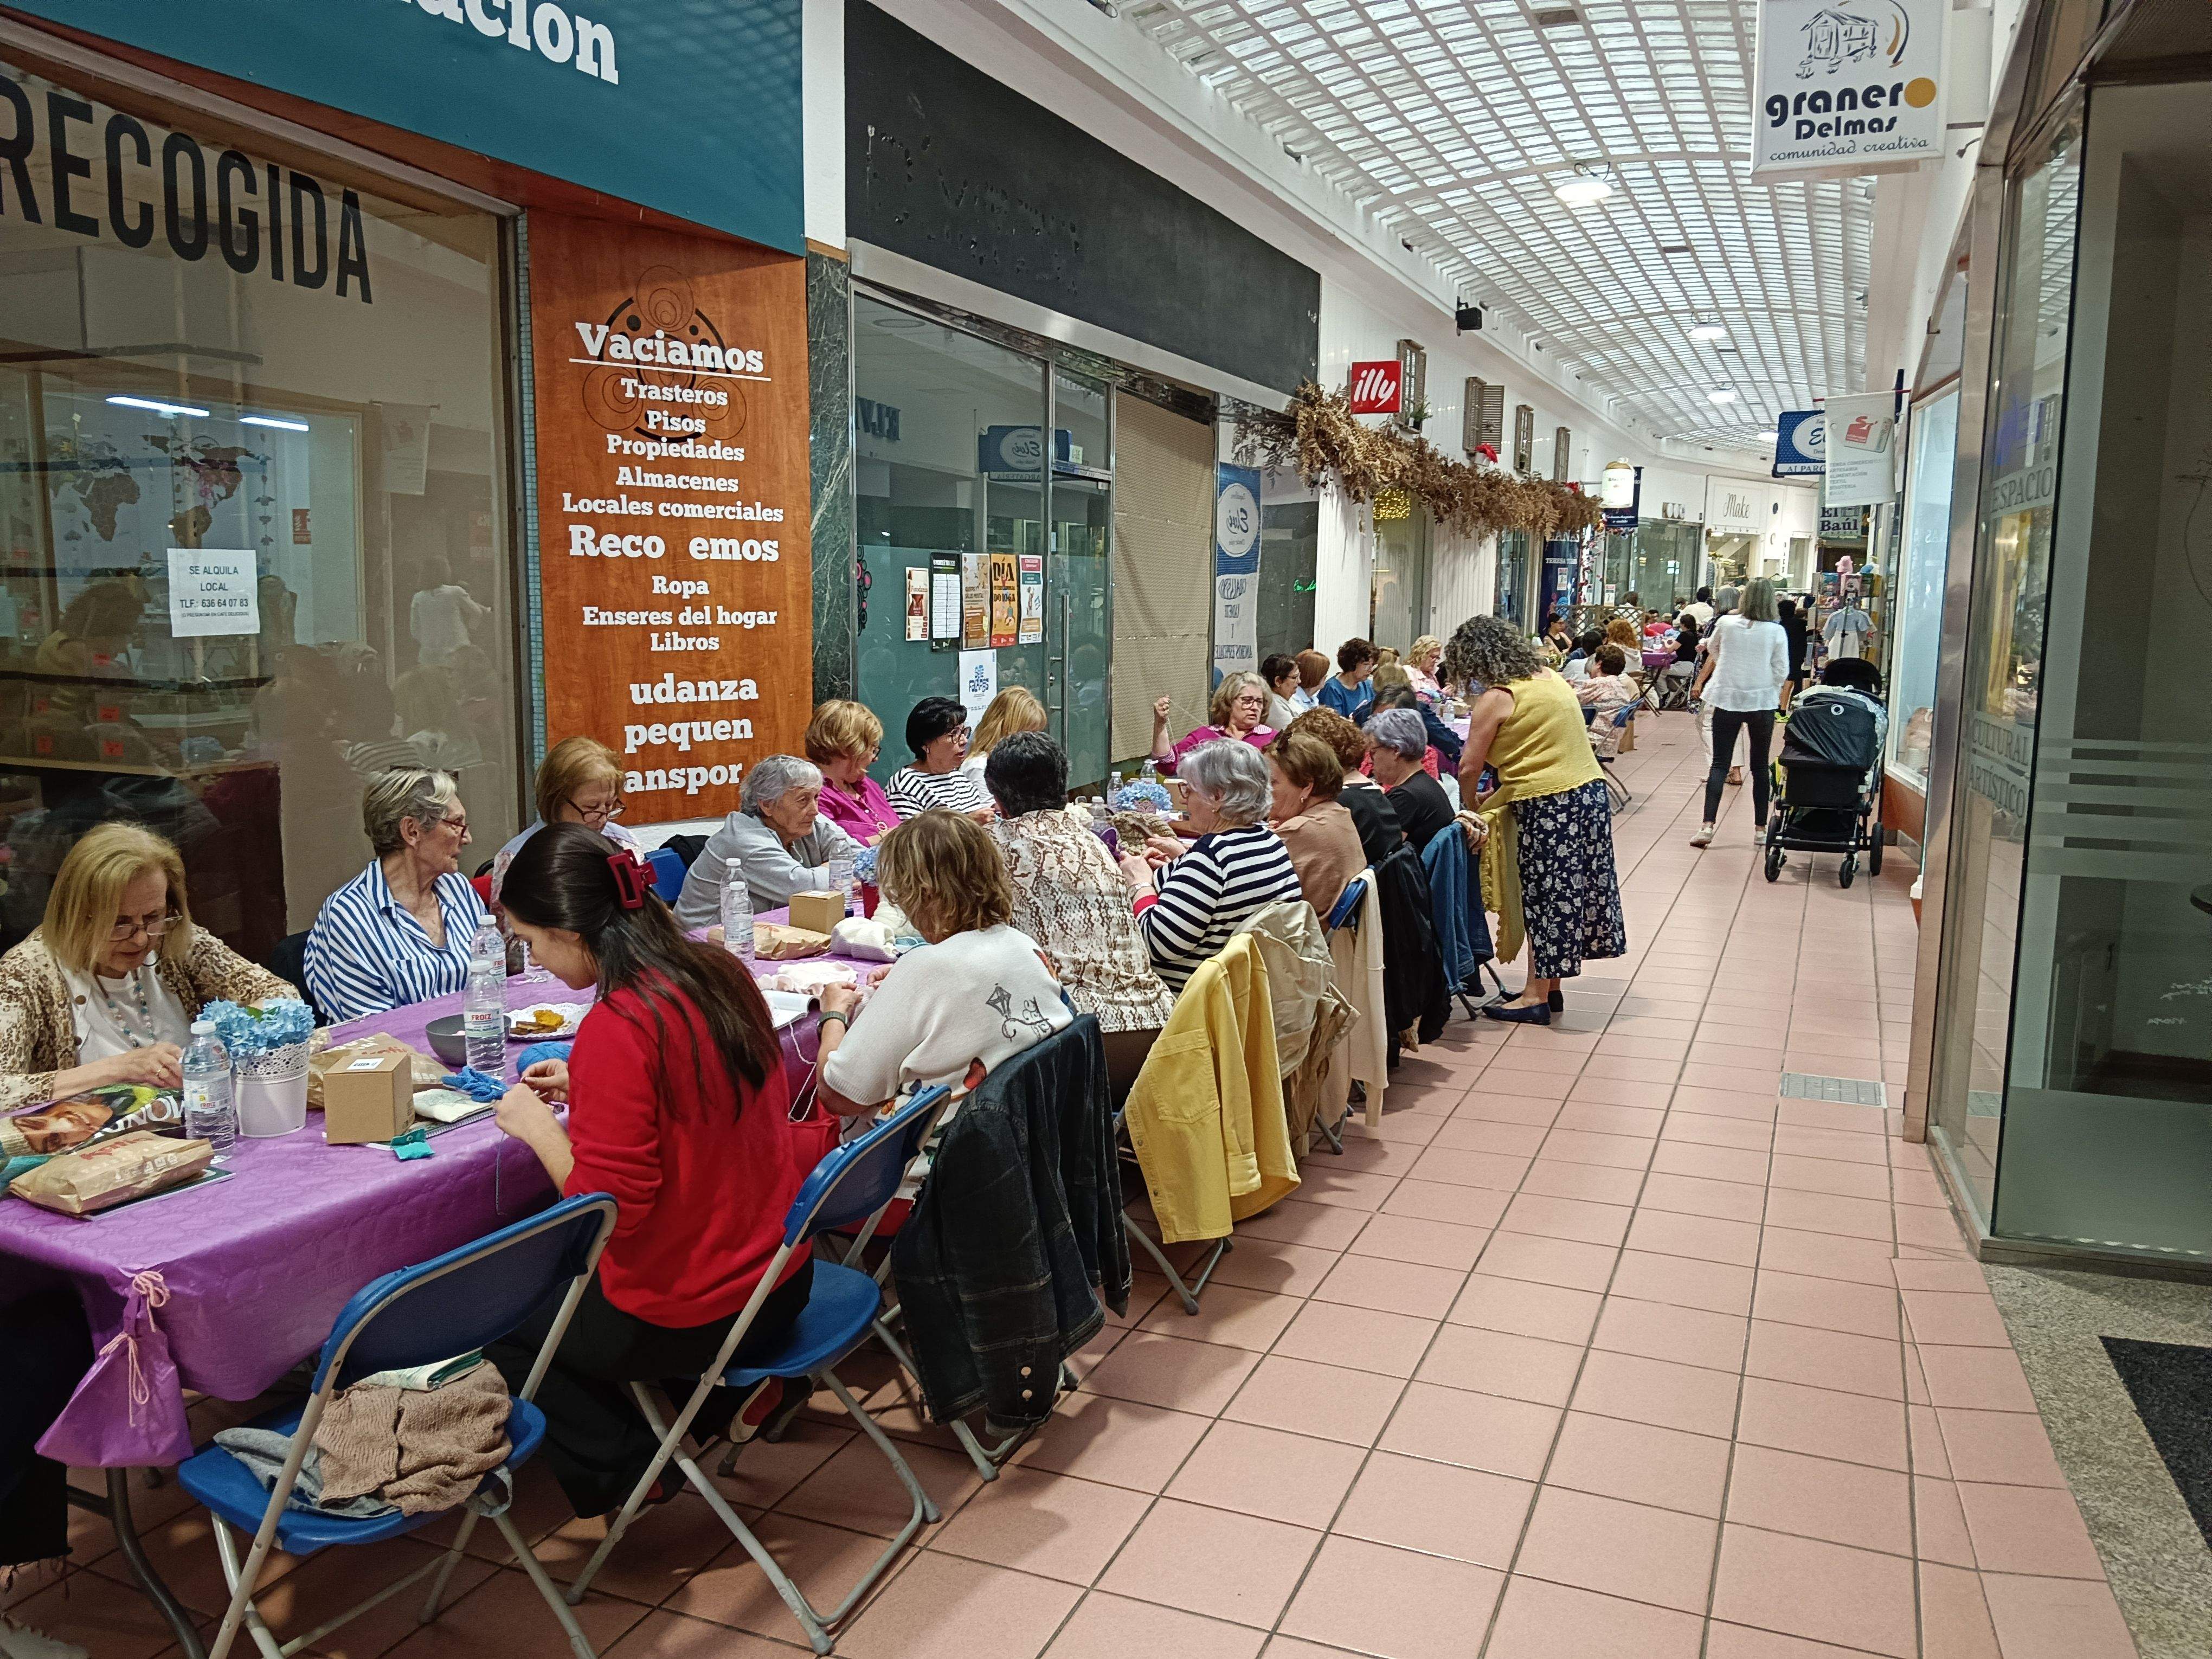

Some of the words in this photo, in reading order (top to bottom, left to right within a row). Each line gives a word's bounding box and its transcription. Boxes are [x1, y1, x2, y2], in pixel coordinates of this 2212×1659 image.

[1795, 116, 1898, 140] Delmas
[1770, 140, 1856, 160] comunidad
[1863, 136, 1929, 152] creativa
[575, 321, 764, 373] Vaciamos
[621, 378, 728, 406] Trasteros
[1354, 368, 1397, 408] illy
[647, 410, 706, 433] Pisos
[607, 434, 745, 461] Propiedades
[616, 466, 739, 492] Almacenes
[1991, 466, 2053, 513] ESPACIO
[562, 492, 653, 516] Locales
[658, 501, 784, 522] comerciales
[1723, 492, 1751, 519] Make
[1820, 506, 1838, 517] El
[1819, 517, 1859, 531] Baúl
[189, 565, 200, 575] SE
[203, 566, 239, 575] ALQUILA
[993, 557, 1015, 582] DÍA
[201, 582, 228, 591] LOCAL
[652, 575, 710, 599] Ropa
[201, 599, 215, 608] 636
[217, 599, 227, 607] 64
[228, 599, 237, 607] 07
[240, 598, 248, 607] 83
[582, 606, 672, 626] Enseres
[678, 606, 711, 626] del
[717, 606, 777, 629] hogar
[651, 633, 720, 651] Libros
[629, 673, 759, 705] udanza
[624, 717, 754, 754] pequen
[1972, 718, 2028, 766] CULTURAL
[1970, 764, 2025, 819] ARTÍSTICO
